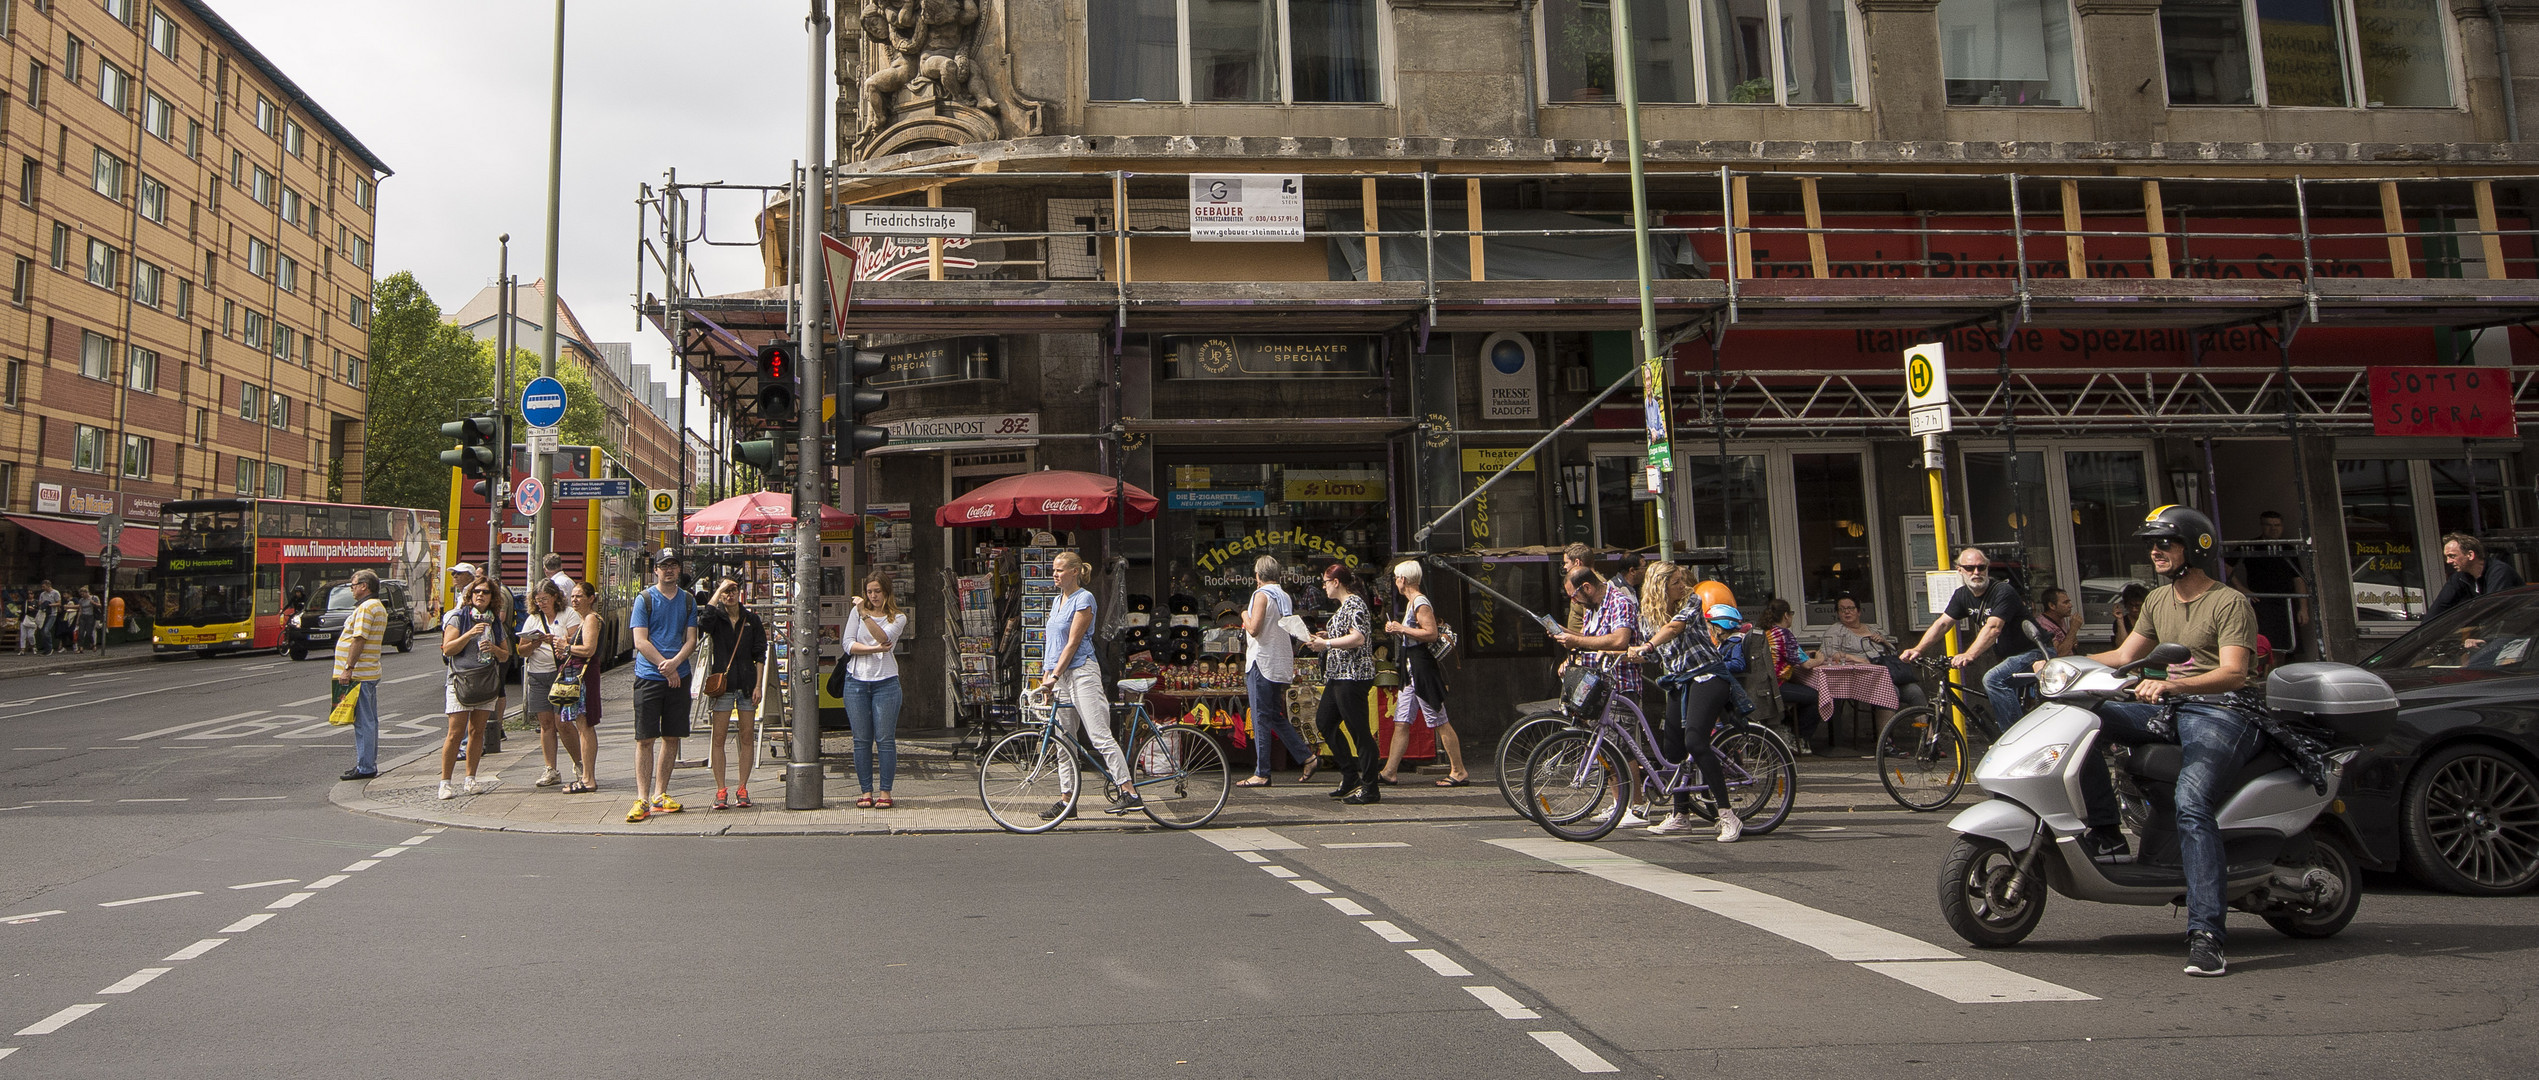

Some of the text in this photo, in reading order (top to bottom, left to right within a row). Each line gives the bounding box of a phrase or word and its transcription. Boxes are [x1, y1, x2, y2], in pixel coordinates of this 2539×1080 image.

[1195, 207, 1244, 216] GEBAUER
[865, 212, 956, 230] Friedrichstraße
[1196, 228, 1300, 237] www.gebauer-steinmetz.de
[1208, 339, 1226, 348] THAT
[890, 350, 944, 362] HN PLAYER
[890, 361, 932, 372] SPECIAL
[1912, 364, 1925, 388] H
[2388, 372, 2480, 394] SOTTO
[1492, 388, 1529, 398] PRESSE
[1492, 407, 1531, 415] RADLOFF
[2387, 404, 2482, 424] SOPRA
[1932, 415, 1937, 425] h
[904, 422, 985, 436] MORGENPOST
[42, 490, 58, 500] GAZI
[1325, 484, 1365, 496] LOTTO
[85, 494, 113, 514] Market
[1042, 498, 1079, 512] Coca-Cola
[966, 504, 994, 518] Coca-Cola
[501, 532, 529, 543] Leis
[1196, 526, 1359, 573] Theaterkasse
[2355, 542, 2411, 556] Pizza, Pasta
[170, 560, 185, 570] M29
[2369, 559, 2402, 571] & Salat
